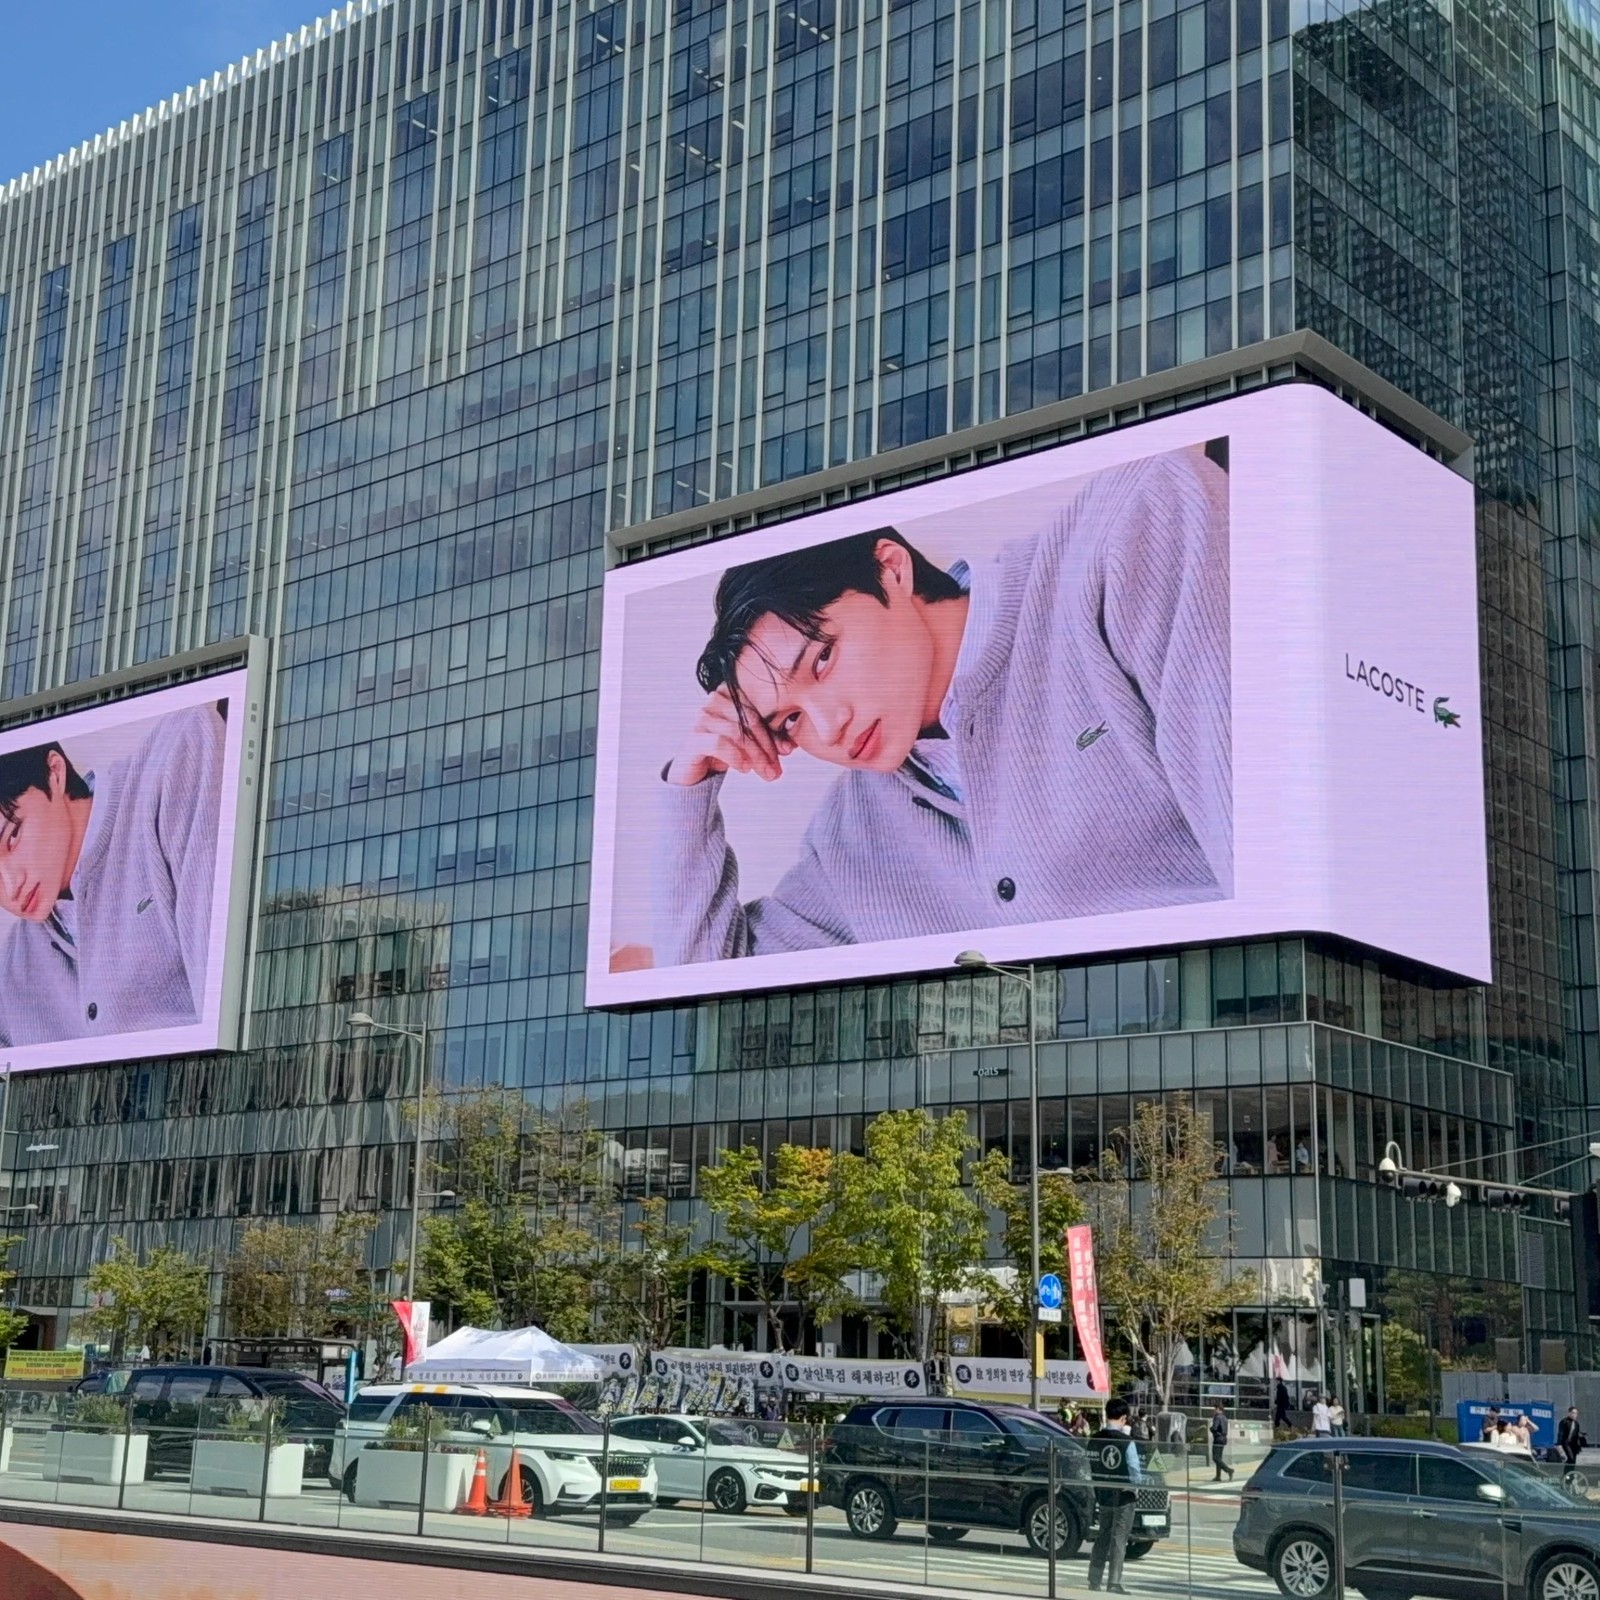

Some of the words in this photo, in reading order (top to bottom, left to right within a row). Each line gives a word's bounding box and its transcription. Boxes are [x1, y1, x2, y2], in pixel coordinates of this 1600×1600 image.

[1346, 652, 1425, 713] LACOSTE
[803, 1367, 845, 1383] 살인특검
[851, 1370, 900, 1386] 해체하라!
